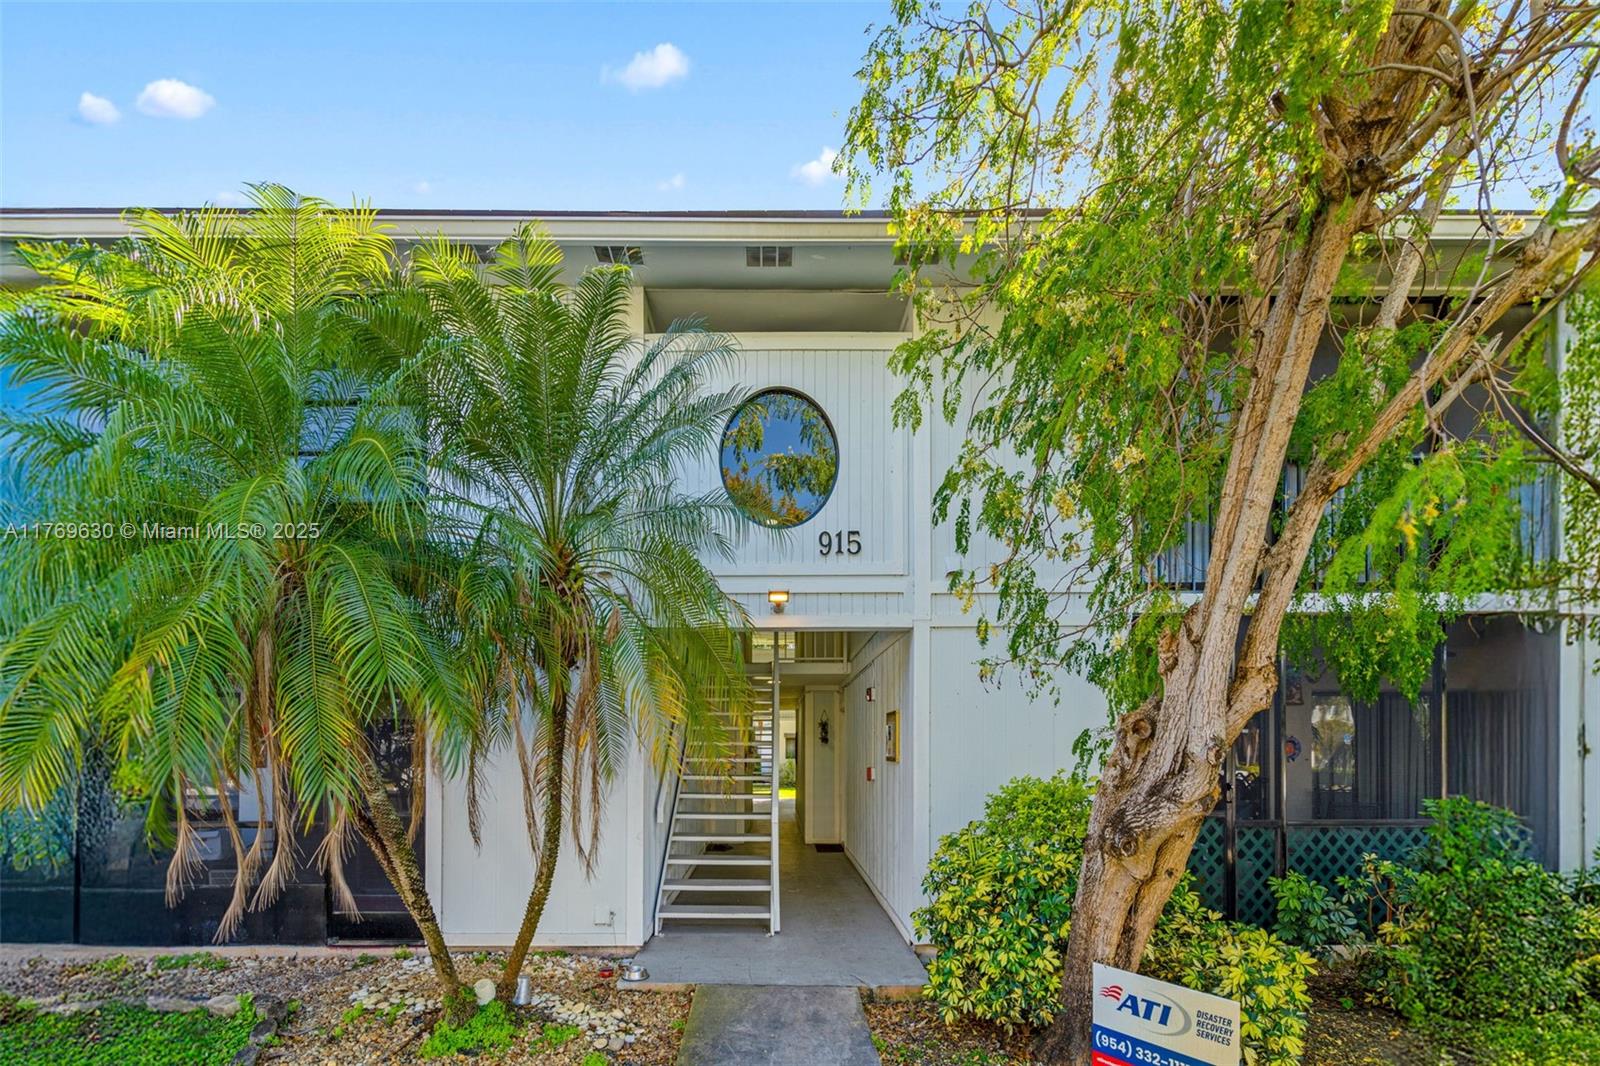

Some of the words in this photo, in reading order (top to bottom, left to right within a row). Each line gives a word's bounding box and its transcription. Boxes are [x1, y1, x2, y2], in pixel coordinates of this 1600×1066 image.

[818, 529, 862, 556] 915
[1116, 993, 1172, 1027] ATI
[1196, 1010, 1232, 1027] DISASTER
[1196, 1020, 1234, 1037] RECOVERY
[1196, 1029, 1232, 1047] SERVICES
[1096, 1030, 1132, 1058] (954)
